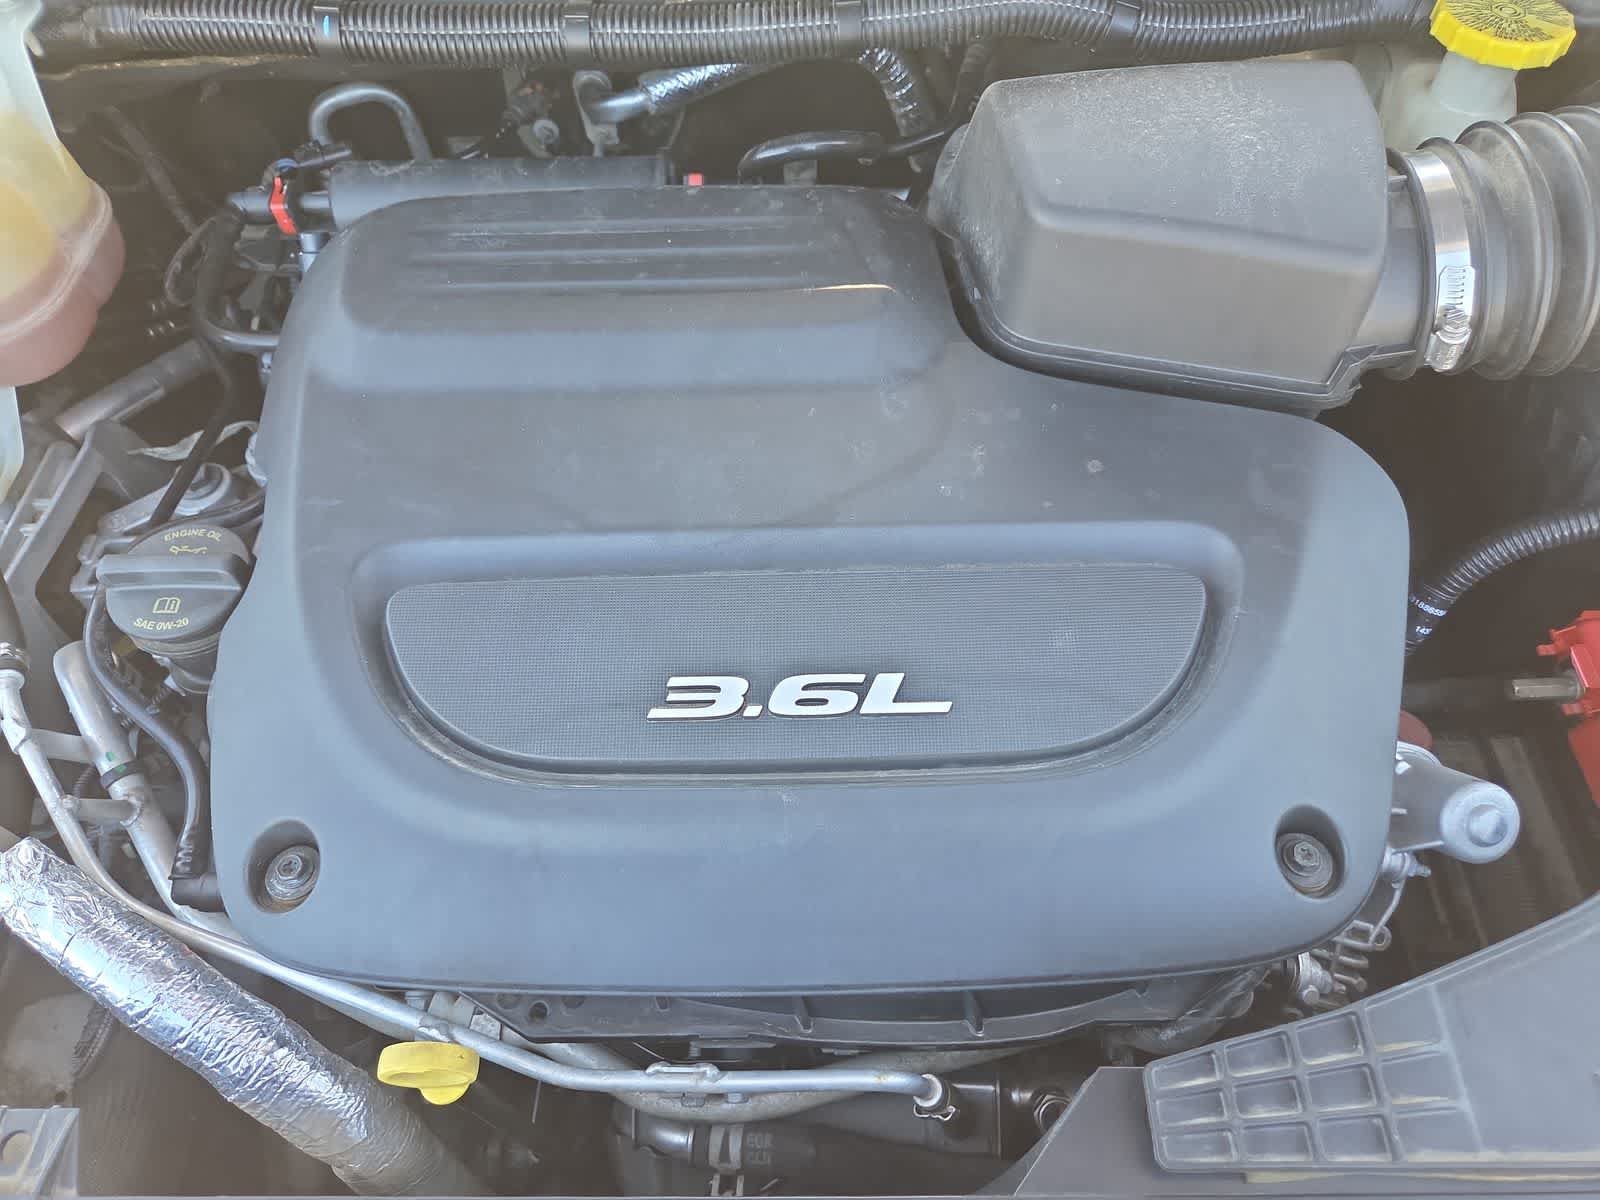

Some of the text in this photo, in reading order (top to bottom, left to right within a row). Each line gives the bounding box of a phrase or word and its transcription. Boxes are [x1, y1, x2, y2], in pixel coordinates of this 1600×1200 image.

[164, 528, 222, 542] ENGINE OIL
[134, 617, 189, 631] SAE 0W-20
[646, 672, 953, 721] 3.6L
